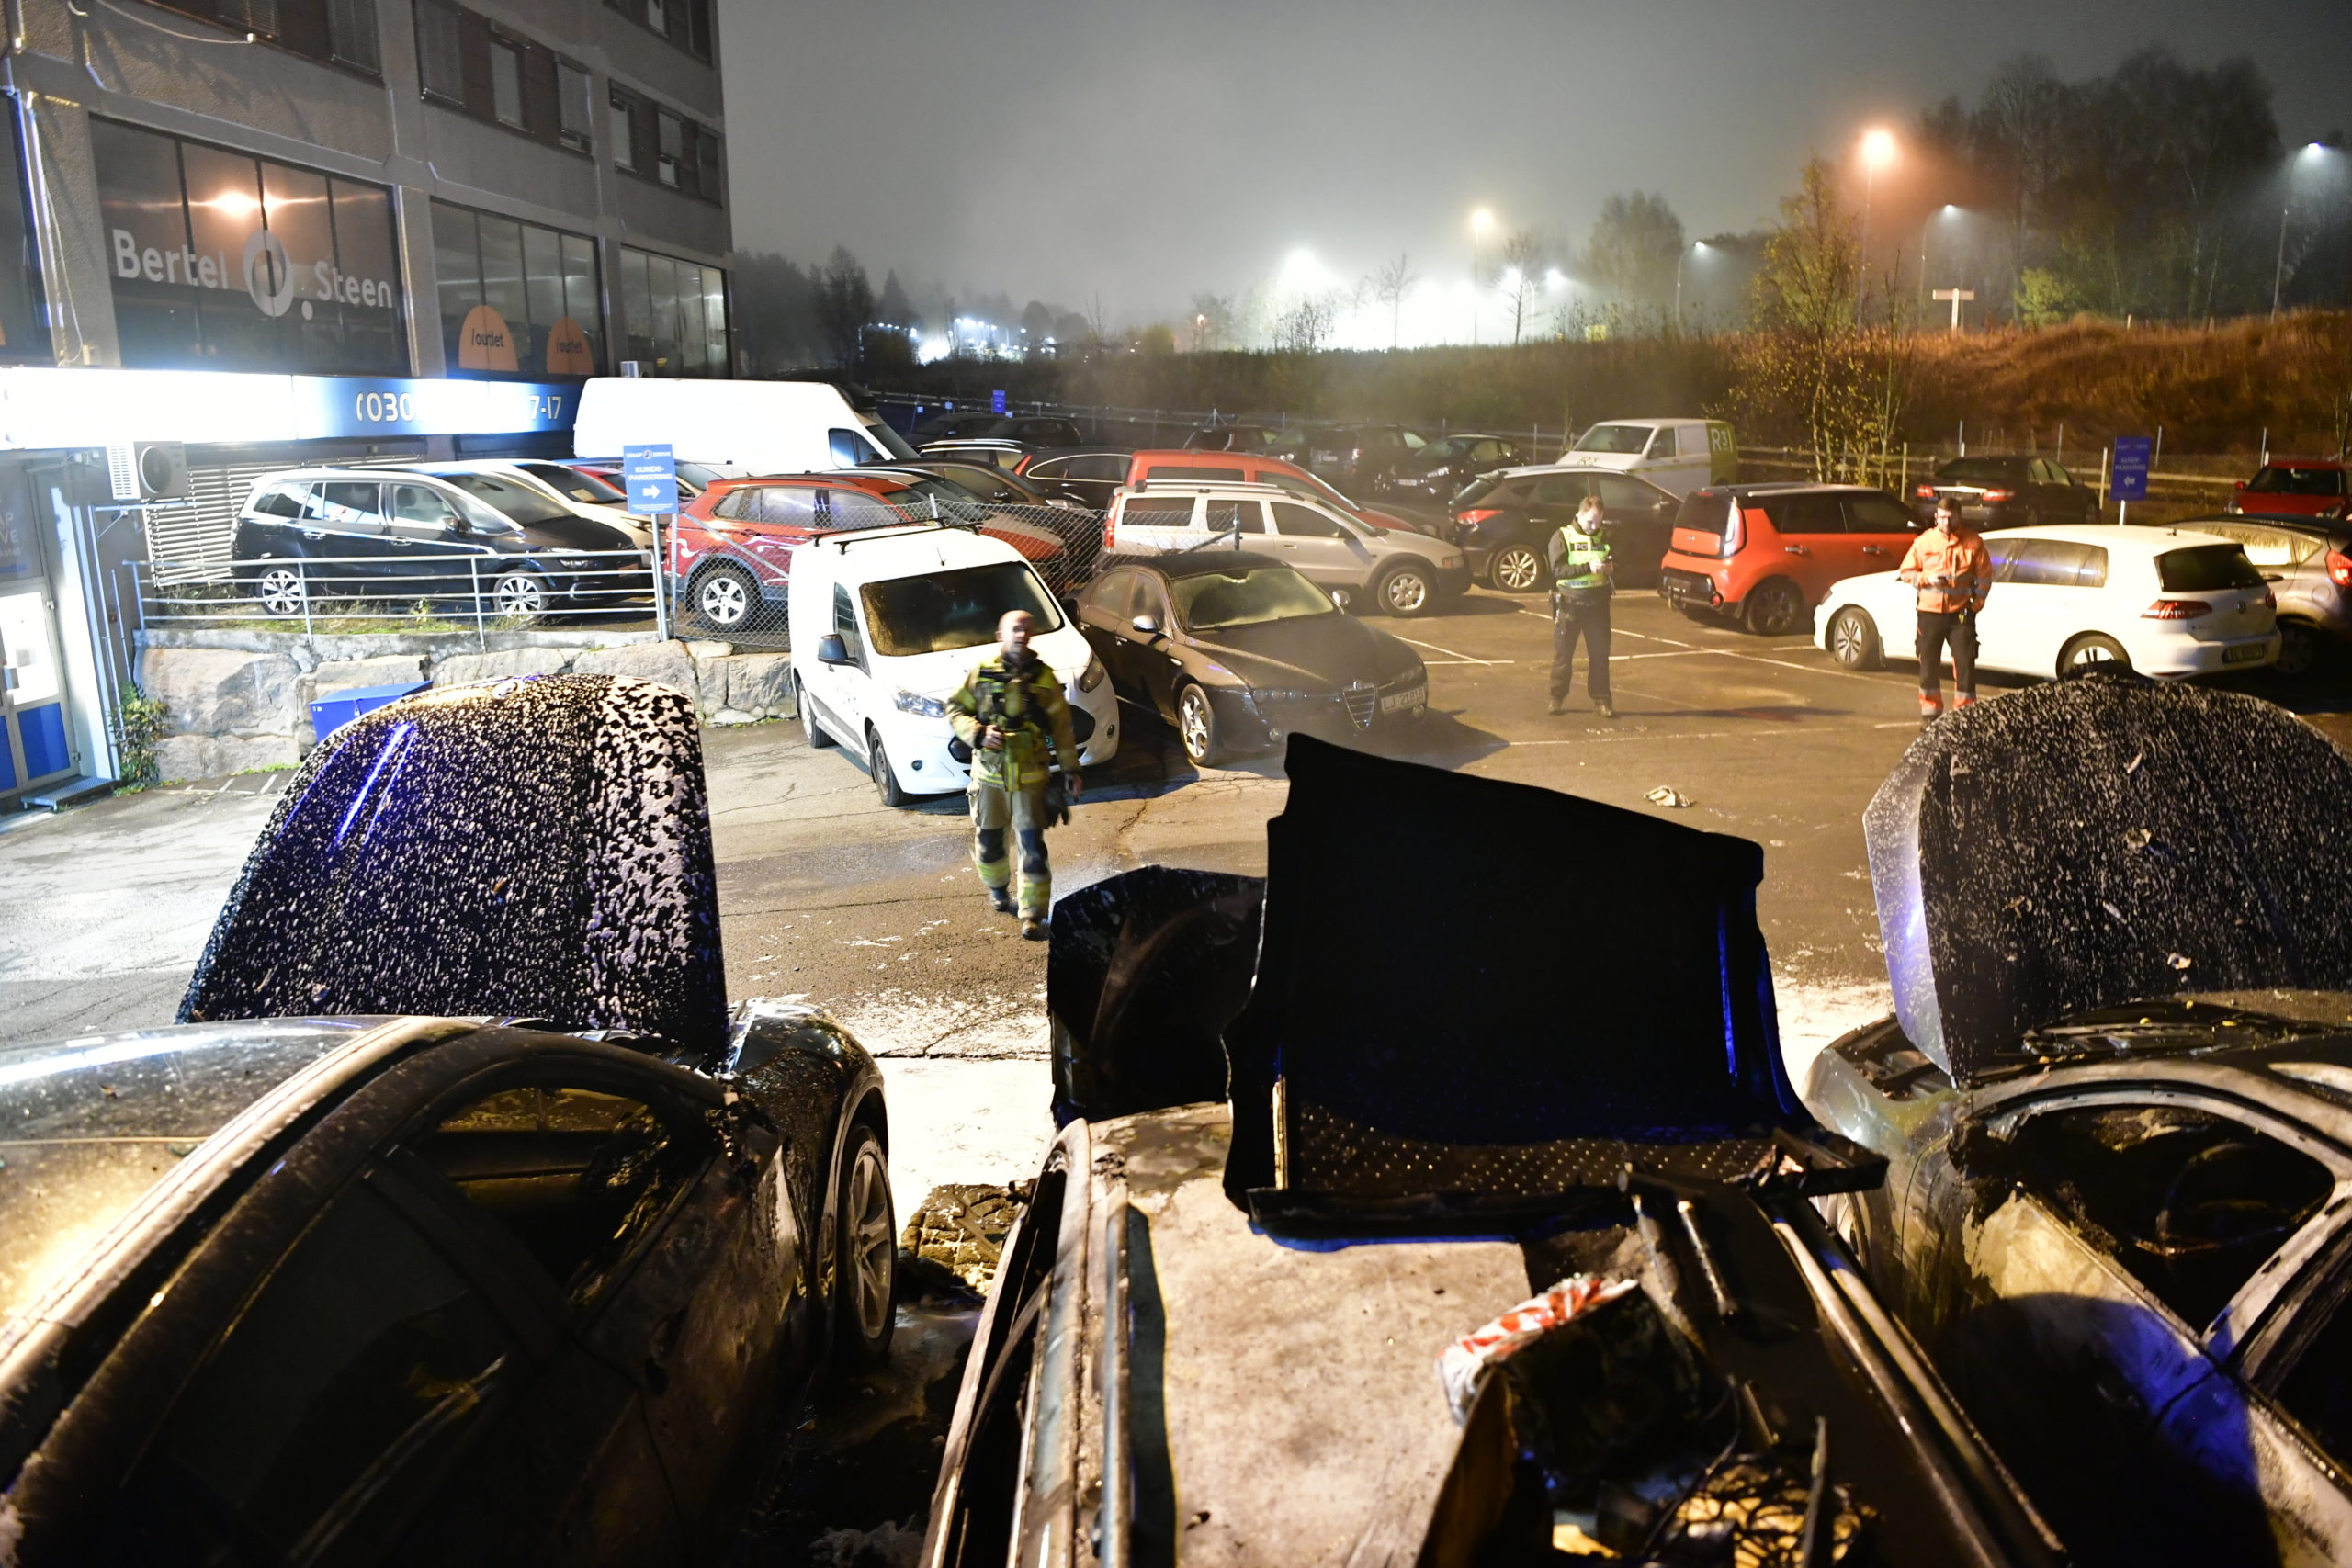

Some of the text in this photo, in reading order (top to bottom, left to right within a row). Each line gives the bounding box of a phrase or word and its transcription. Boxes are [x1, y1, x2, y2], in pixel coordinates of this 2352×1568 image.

[112, 229, 228, 289] Bertel
[314, 261, 392, 308] Steen
[628, 473, 673, 481] PARKERING
